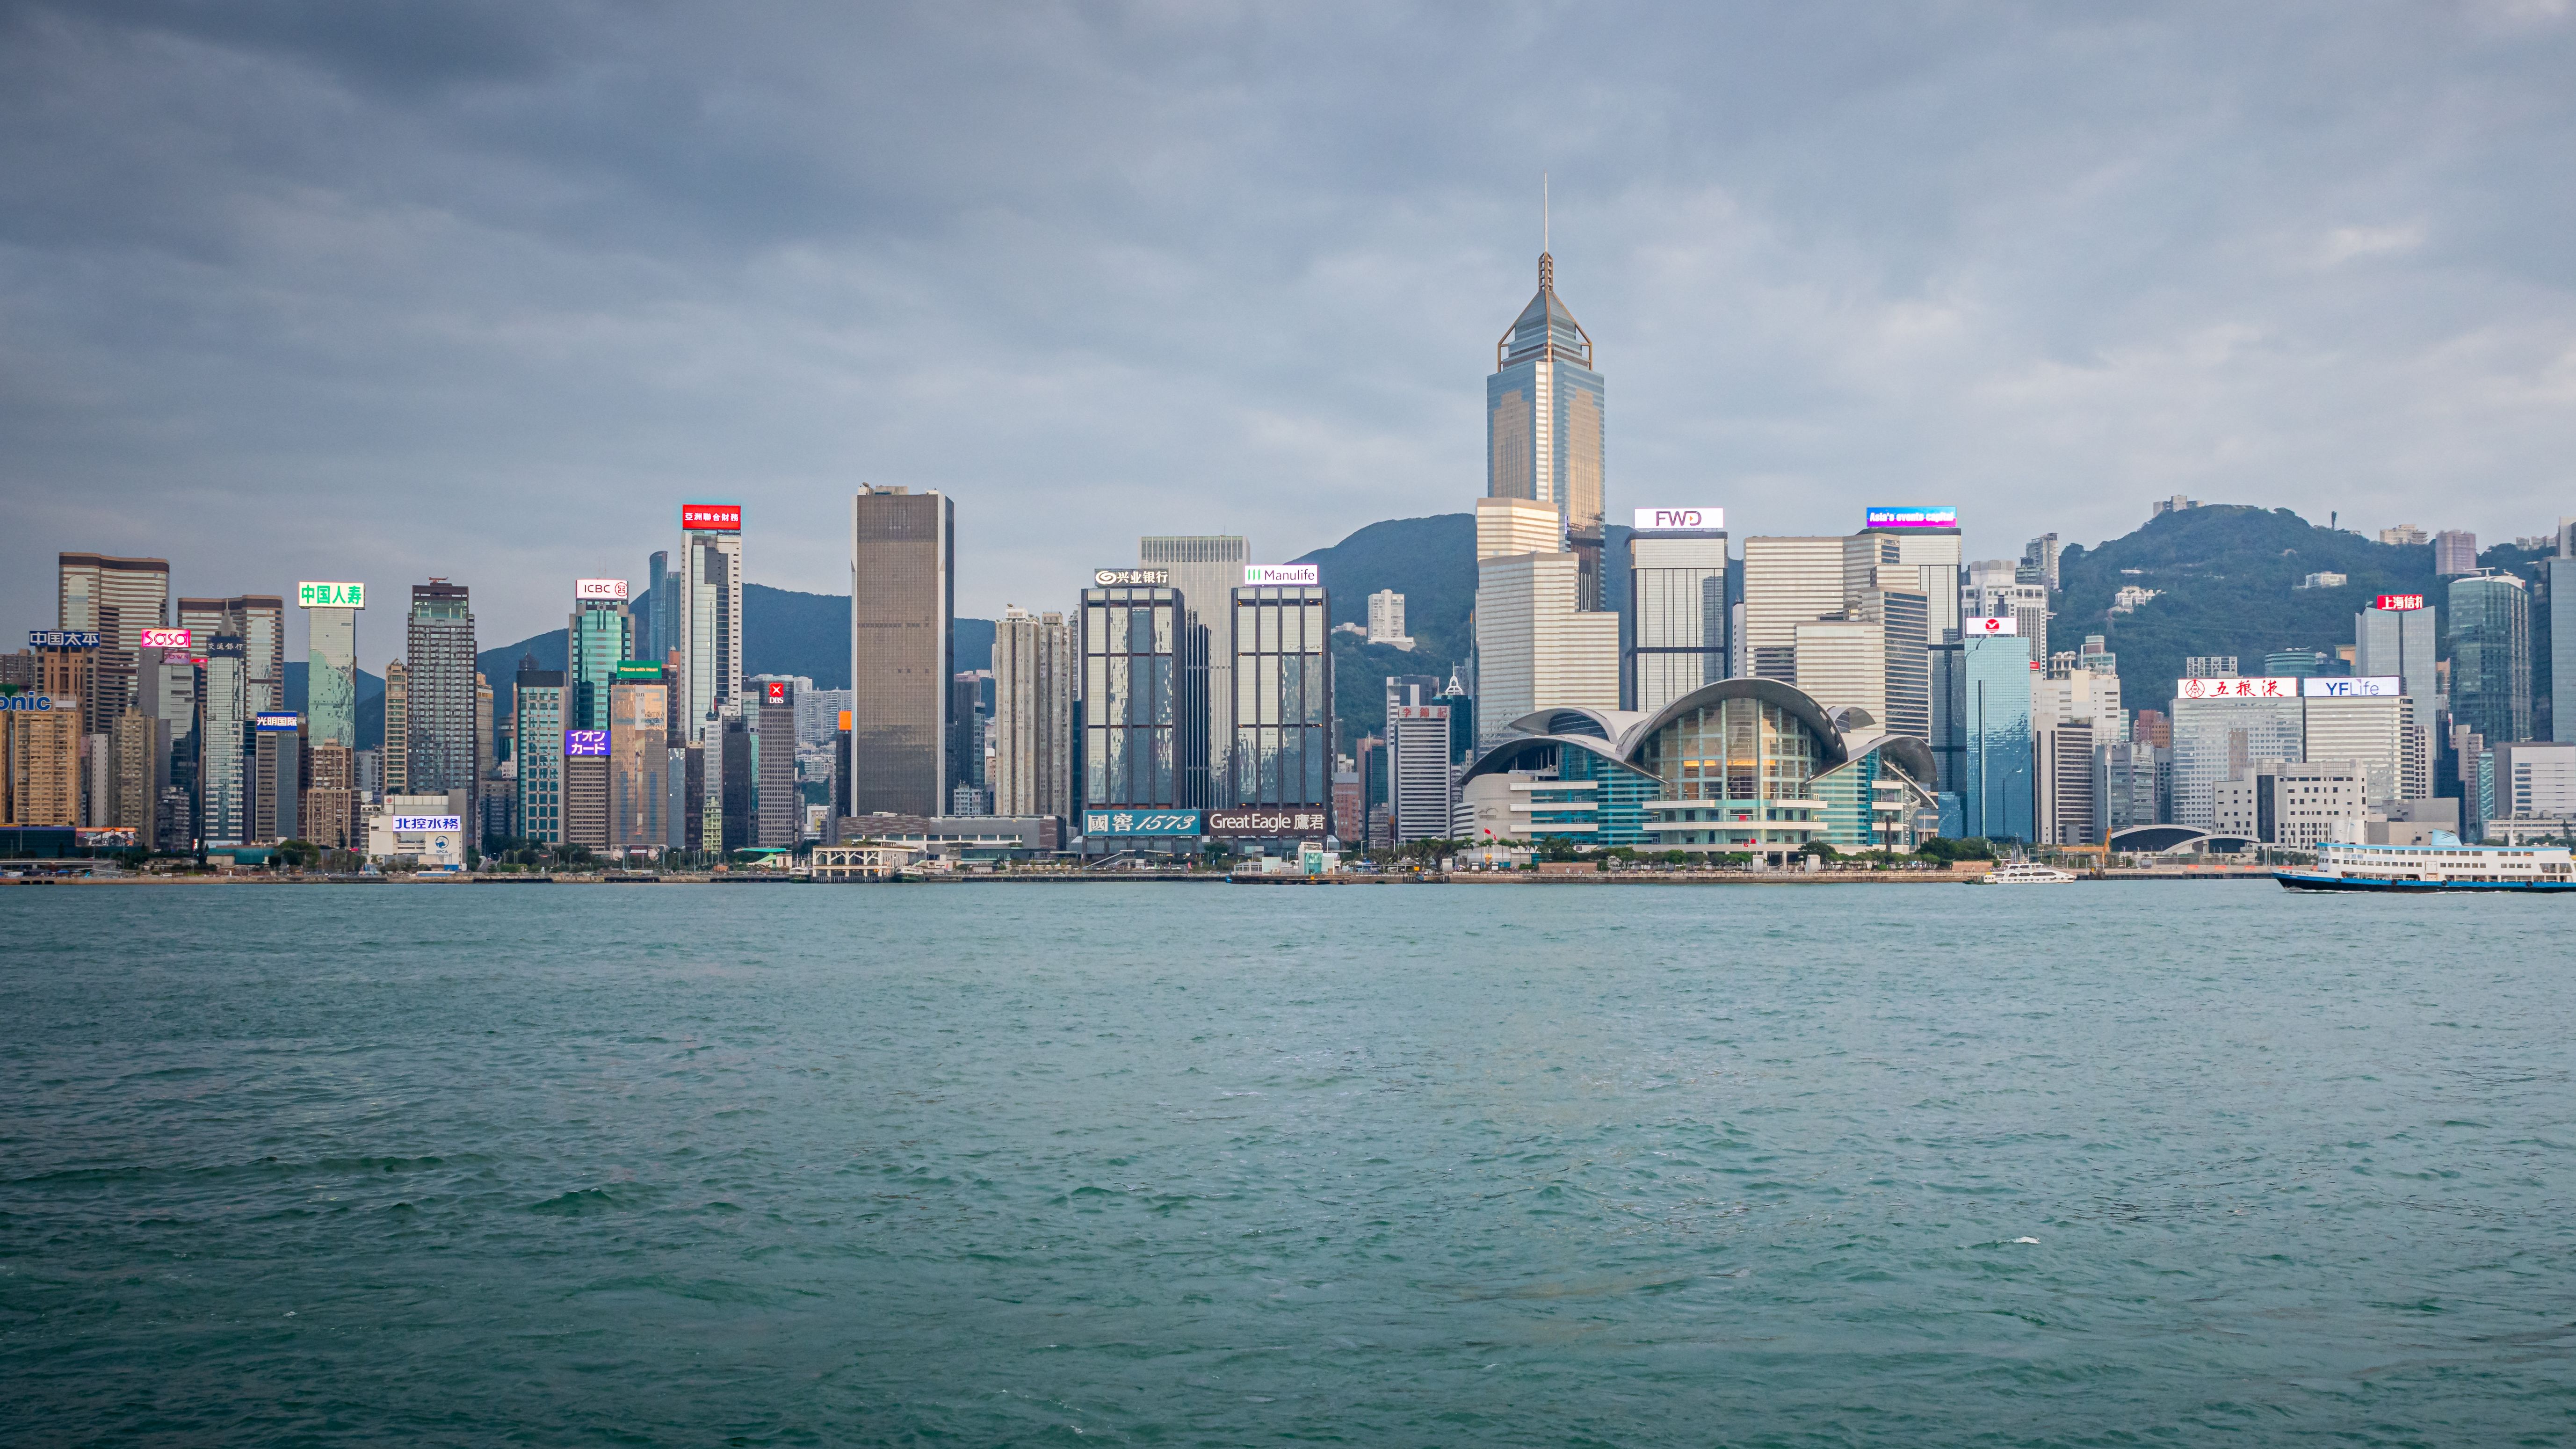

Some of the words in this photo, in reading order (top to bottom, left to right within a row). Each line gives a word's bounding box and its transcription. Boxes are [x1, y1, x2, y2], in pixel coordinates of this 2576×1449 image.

[685, 513, 738, 522] 亞洲聯合財務
[1656, 510, 1701, 526] FWD
[1870, 512, 1894, 522] Asia's
[1896, 513, 1924, 522] events
[1926, 512, 1953, 523] capital
[1116, 571, 1168, 584] 兴业银行
[1265, 569, 1315, 580] Manulife
[302, 584, 362, 604] 中国人寿
[30, 632, 99, 645] 中国太平
[2208, 680, 2284, 697] 五粮液
[257, 717, 297, 726] 光明国际
[571, 731, 605, 742] イオン
[571, 743, 605, 754] カード
[395, 818, 458, 829] 北控水務
[1210, 813, 1250, 829] Great
[1252, 813, 1291, 833] Eagle
[1294, 814, 1325, 830] 鷹君
